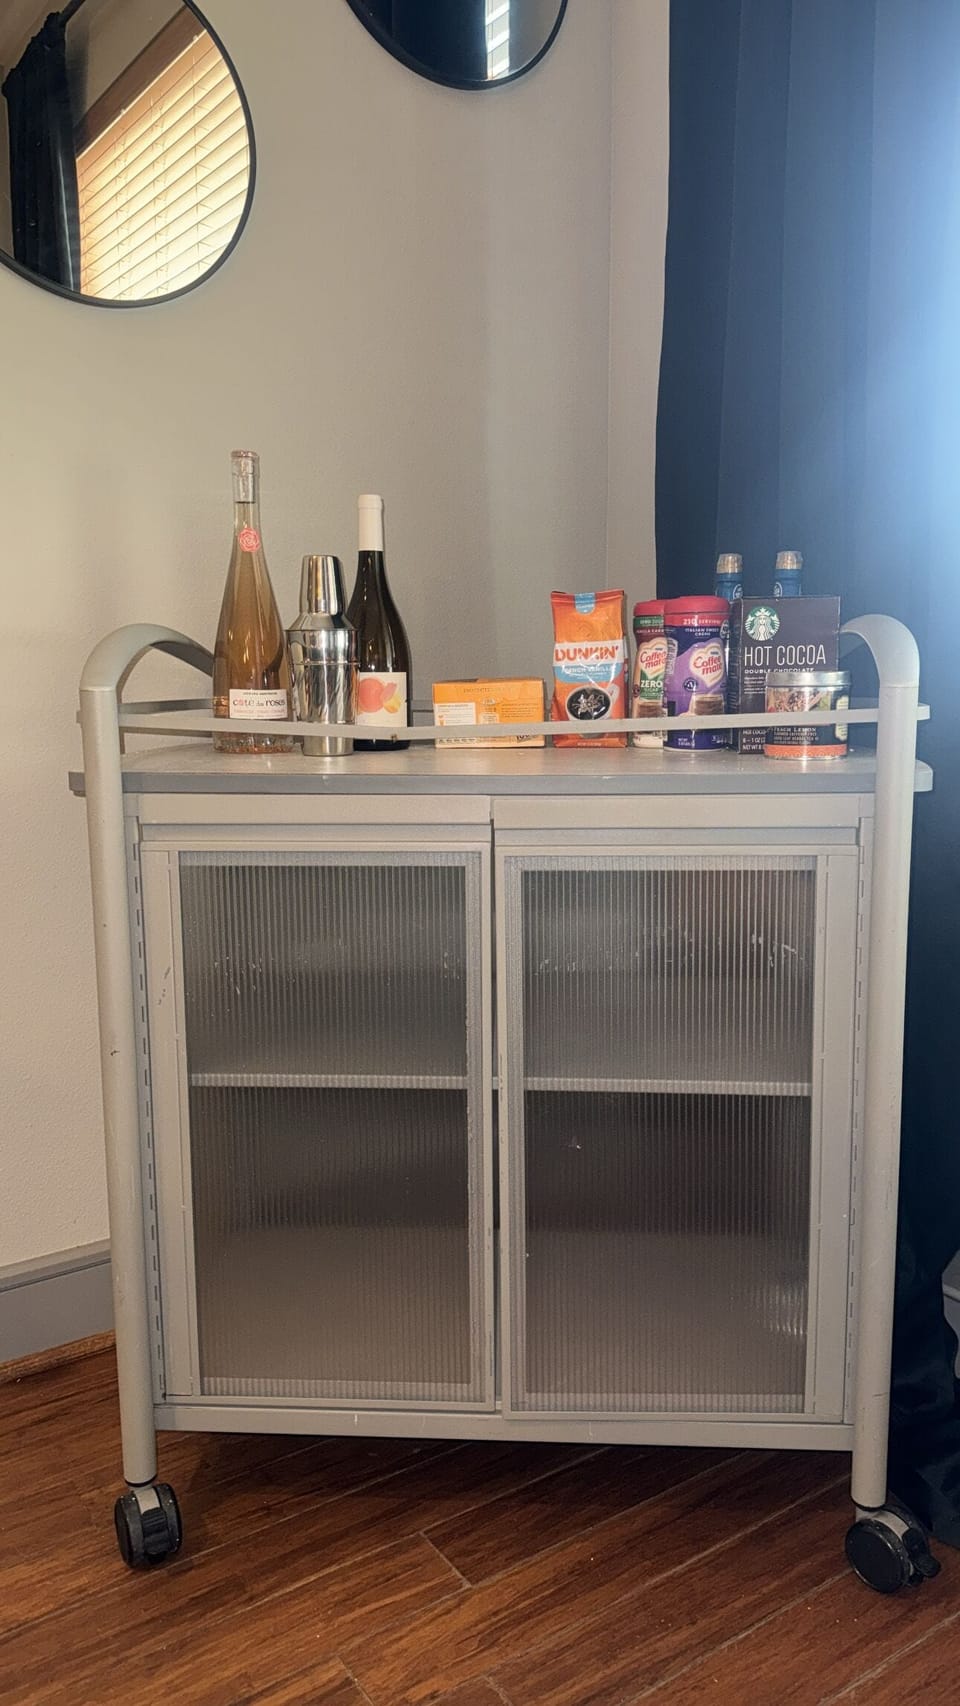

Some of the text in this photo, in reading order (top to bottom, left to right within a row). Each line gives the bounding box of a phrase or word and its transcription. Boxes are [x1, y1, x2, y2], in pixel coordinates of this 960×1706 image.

[554, 645, 619, 662] DUNKIN'
[640, 651, 667, 663] Coffee
[744, 644, 827, 667] HOT COCOA
[645, 659, 667, 669] mate
[693, 656, 722, 669] Coffee
[640, 680, 664, 688] ZERO
